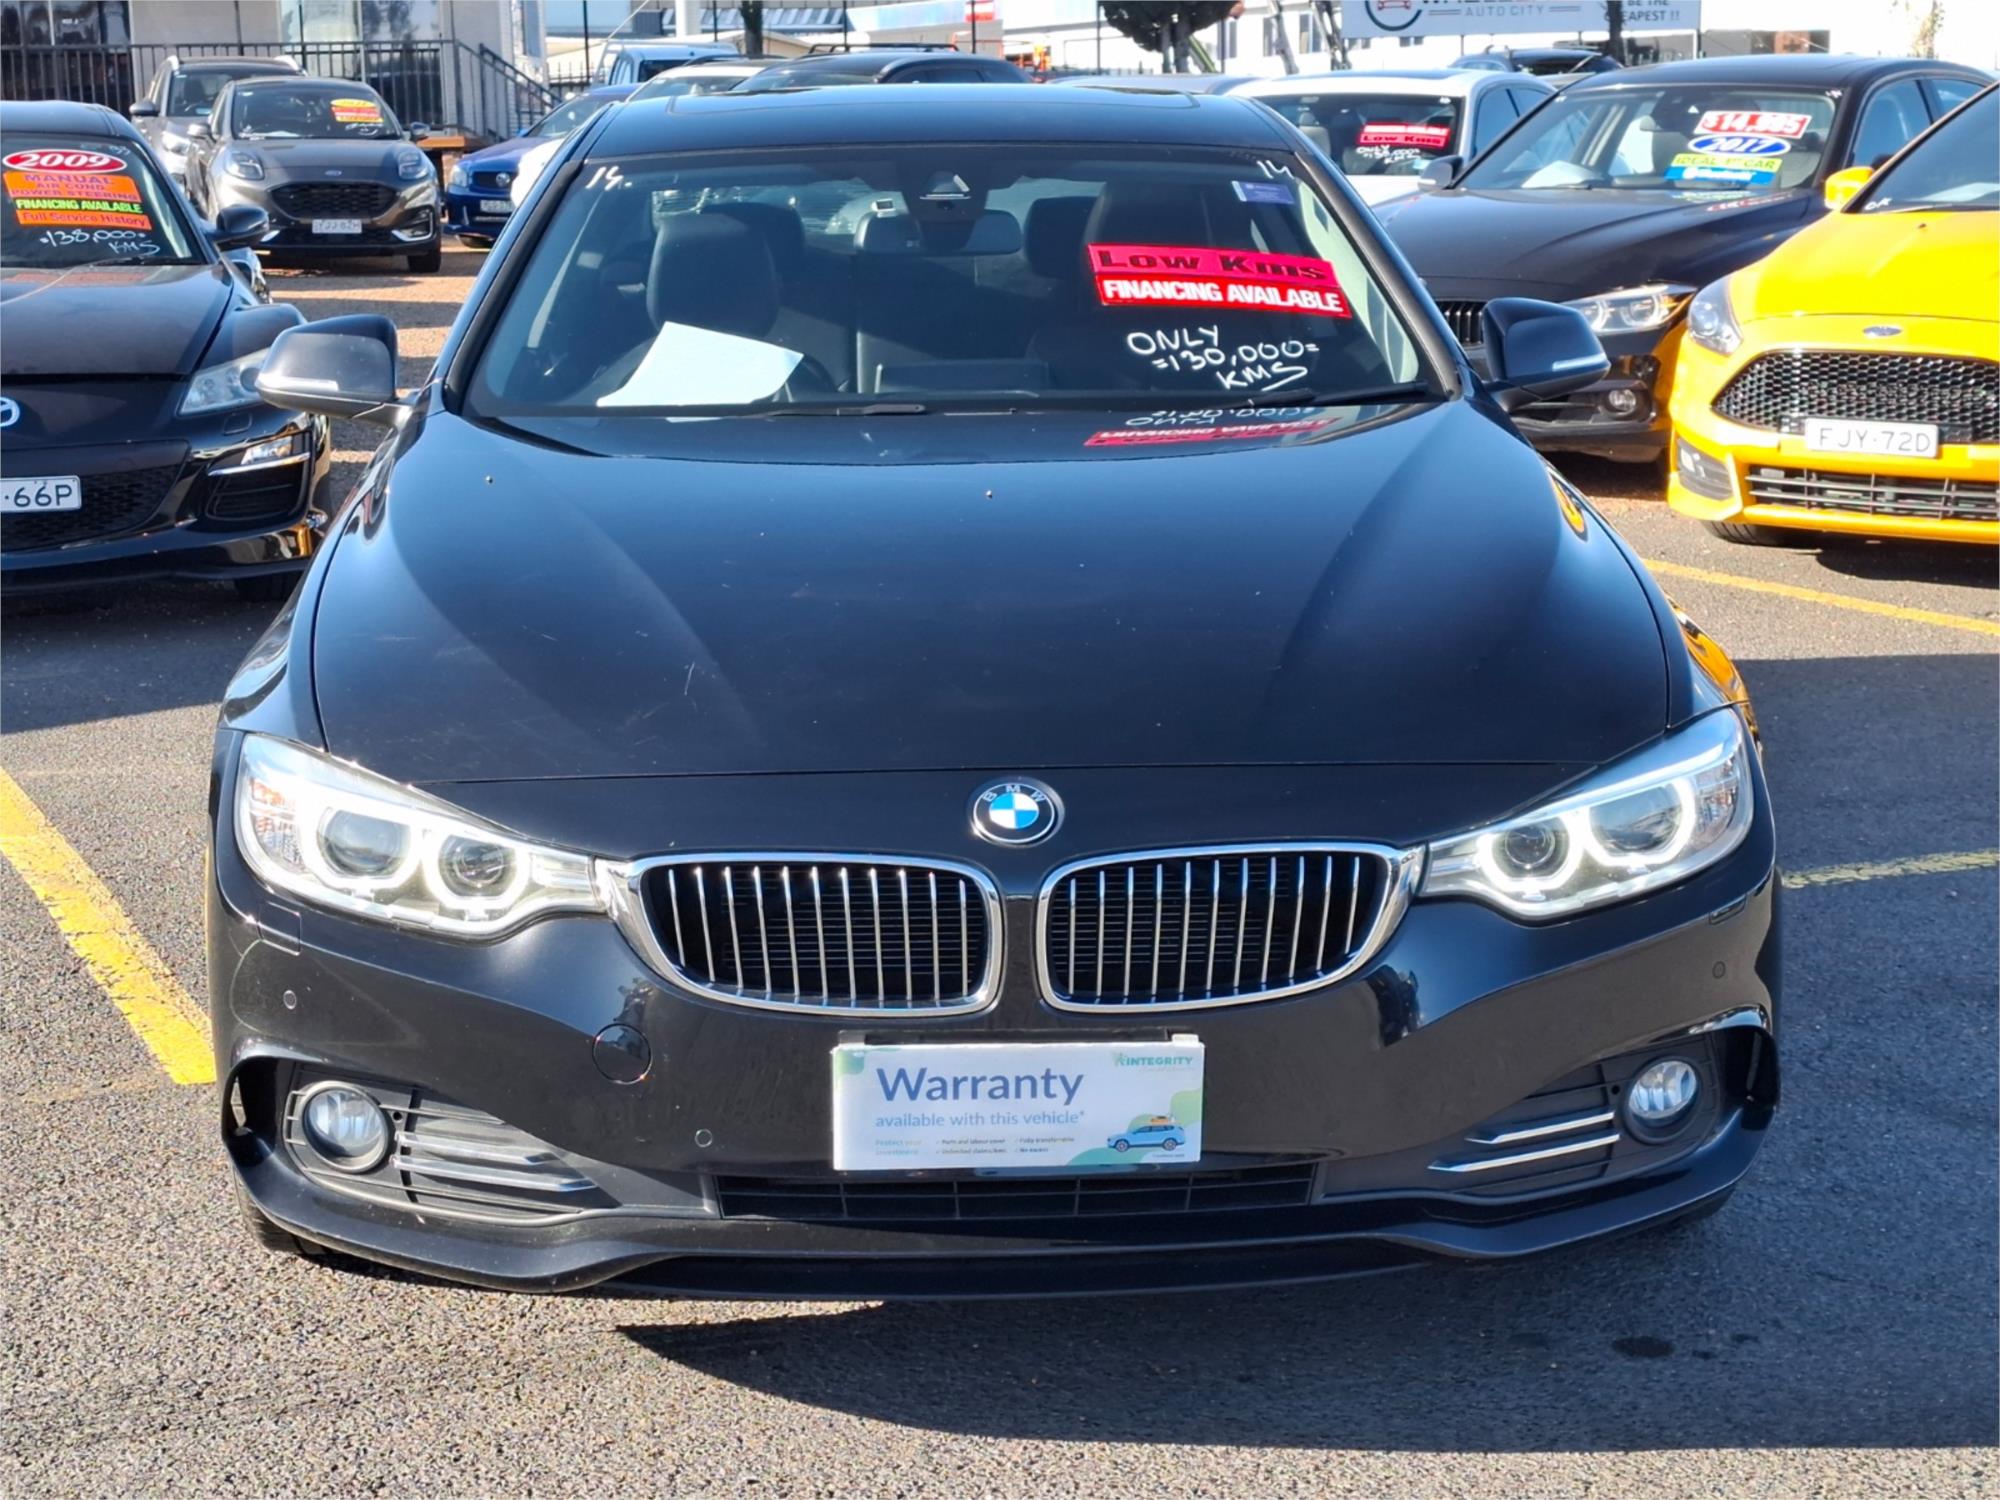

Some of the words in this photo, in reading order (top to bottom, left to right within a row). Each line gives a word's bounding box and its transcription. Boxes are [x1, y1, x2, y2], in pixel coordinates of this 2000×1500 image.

[1465, 6, 1505, 16] AUTO
[1510, 5, 1544, 16] CITY
[1708, 137, 1771, 153] 2017
[20, 153, 110, 167] 2009
[1743, 160, 1776, 170] CAR
[24, 174, 114, 185] MANUAL
[67, 190, 138, 200] STEERING
[16, 200, 79, 210] FINANCING
[81, 201, 143, 214] AVAILABLE
[23, 212, 47, 222] Full
[50, 213, 97, 223] Service
[101, 214, 146, 226] History
[1097, 250, 1200, 269] Low
[1219, 255, 1330, 280] Kms
[1102, 280, 1222, 301] FINANCING
[1227, 284, 1344, 312] AVAILABLE
[1127, 325, 1219, 355] ONLY
[1216, 362, 1308, 391] KMS
[982, 783, 1046, 802] BMW
[1126, 1056, 1193, 1066] INTEGRITY
[876, 1067, 1084, 1106] Warranty
[875, 1114, 944, 1127] available
[950, 1113, 985, 1126] with
[990, 1112, 1019, 1125] this
